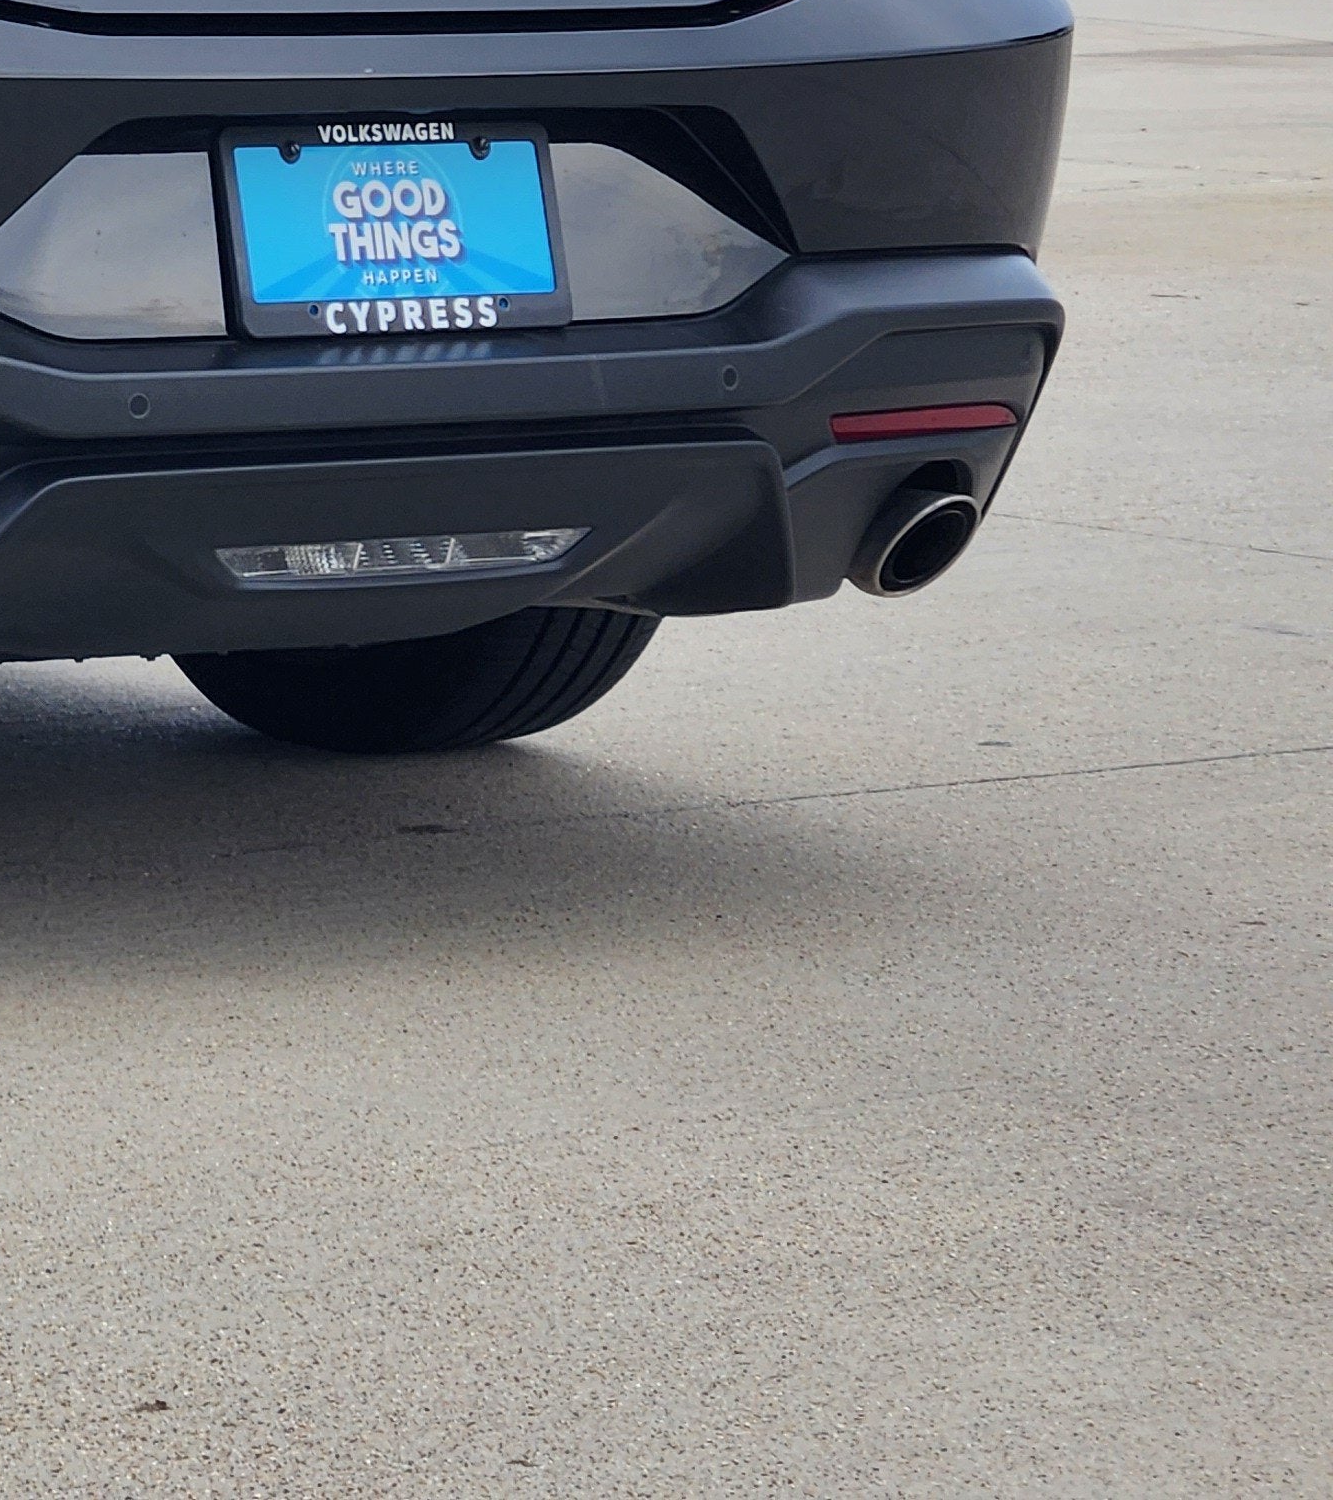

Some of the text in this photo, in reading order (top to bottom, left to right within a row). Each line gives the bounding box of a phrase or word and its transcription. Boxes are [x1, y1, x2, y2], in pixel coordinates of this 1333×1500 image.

[317, 122, 455, 143] VOLKSWAGEN
[351, 161, 420, 176] WHERE
[332, 178, 447, 219] GOOD
[328, 219, 462, 263] THINGS
[362, 268, 438, 285] HAPPEN
[326, 296, 498, 334] CYPRESS
